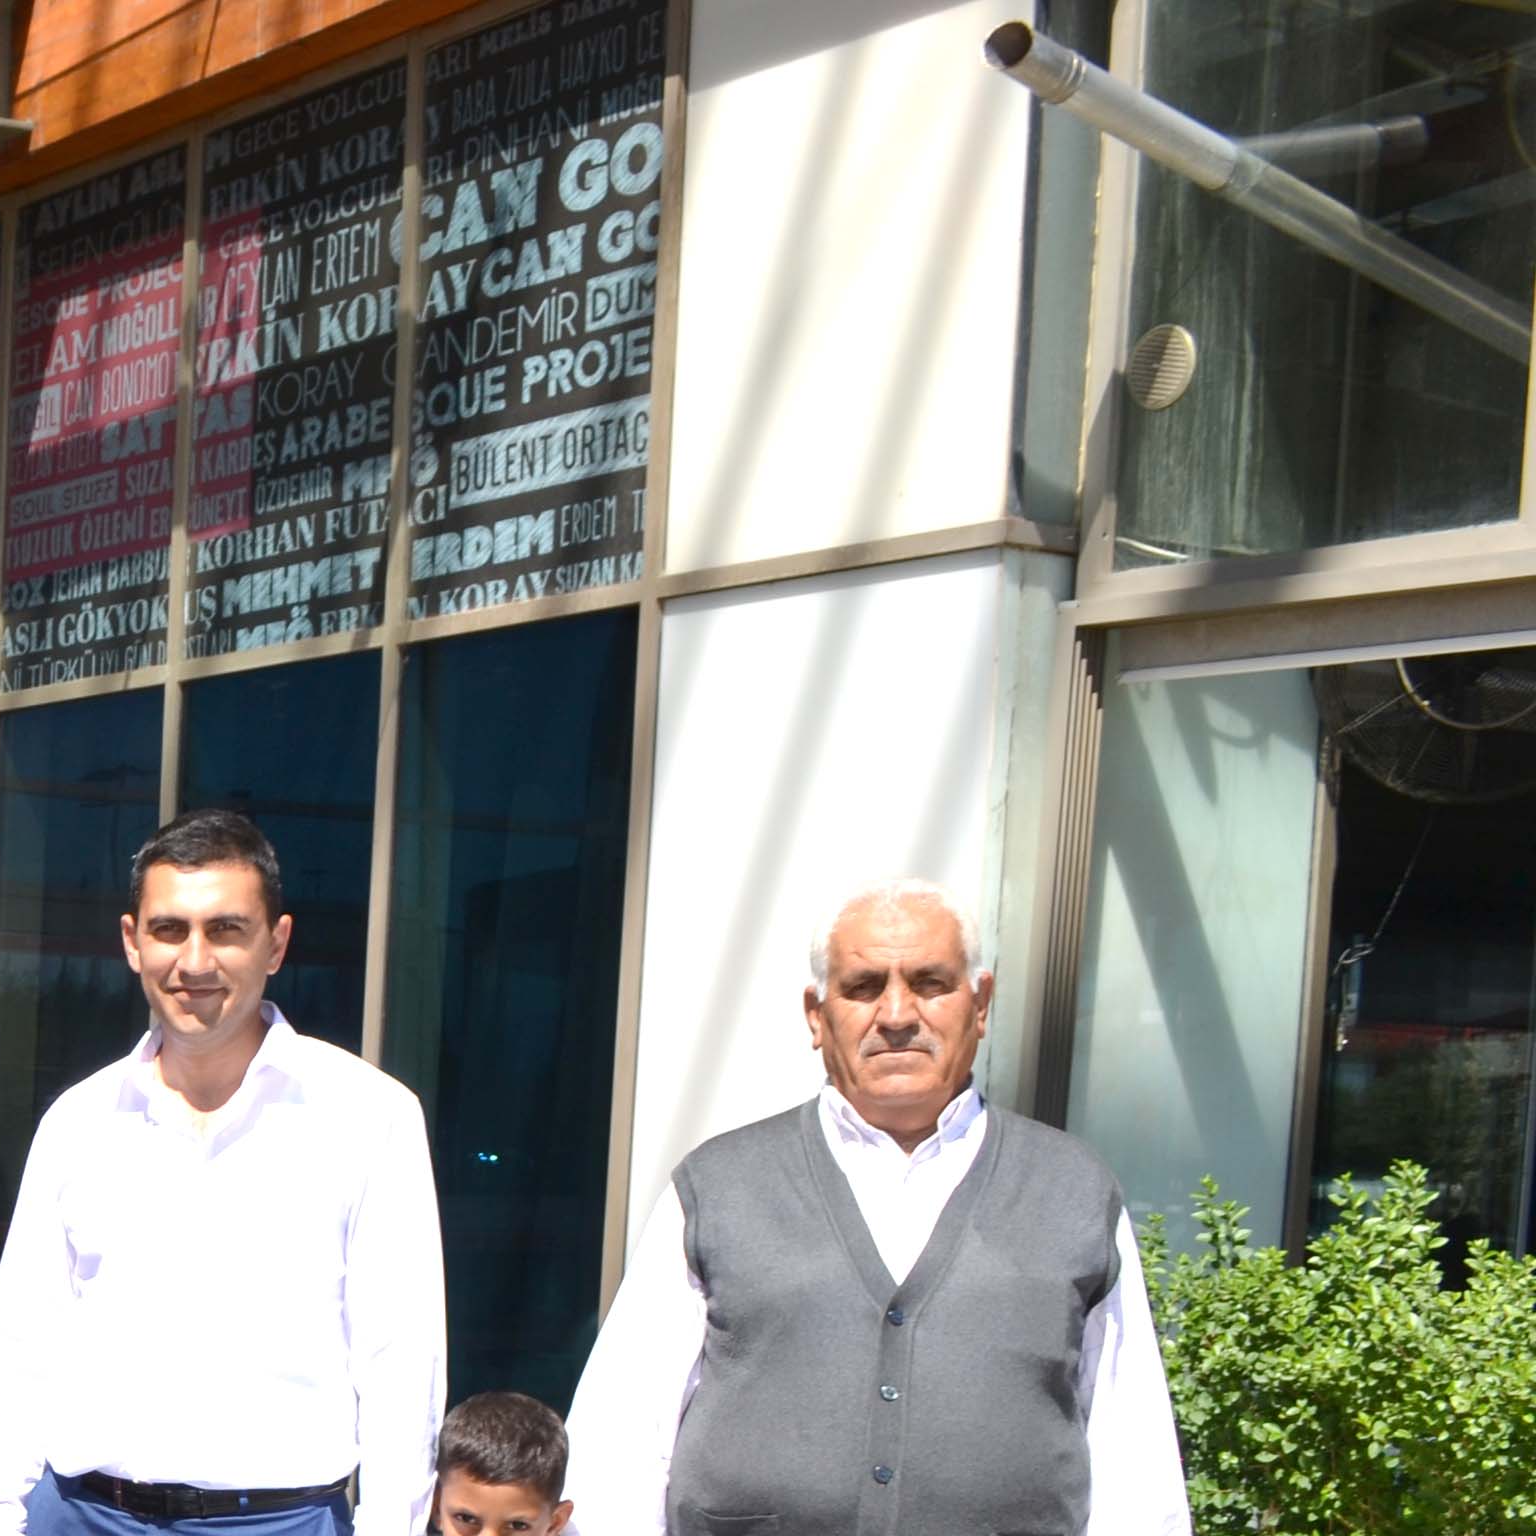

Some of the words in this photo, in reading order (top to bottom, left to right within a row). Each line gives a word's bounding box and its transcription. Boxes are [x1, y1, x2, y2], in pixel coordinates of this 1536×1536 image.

[560, 23, 627, 92] HAYKO
[463, 91, 590, 179] PİNHANİ
[222, 246, 302, 323] CEYLAN
[311, 217, 381, 296] ERTEM
[389, 157, 544, 266] CAN
[64, 374, 96, 425] CAN
[101, 351, 170, 417] BONOMO
[482, 223, 587, 298] CAN
[257, 351, 364, 421] KORAY
[256, 462, 333, 515] ÖZDEMİR
[456, 434, 552, 496] BÜLENT
[196, 513, 318, 575] KORHAN
[223, 547, 381, 617] MEHMET
[411, 508, 556, 582] ERDEM
[560, 495, 617, 547] ERDEM
[439, 567, 552, 617] KORAY
[555, 556, 615, 594] SUZAN
